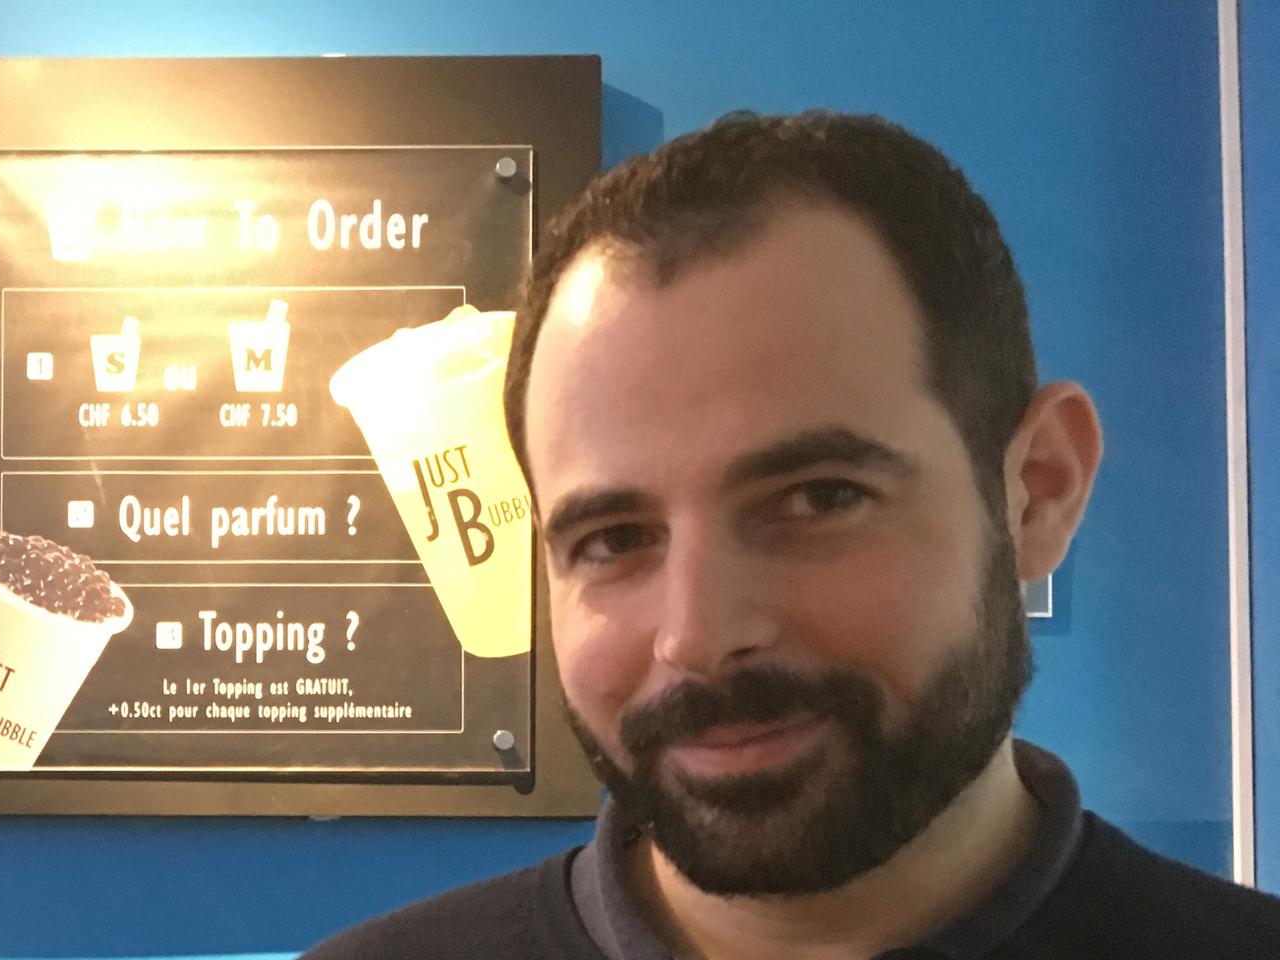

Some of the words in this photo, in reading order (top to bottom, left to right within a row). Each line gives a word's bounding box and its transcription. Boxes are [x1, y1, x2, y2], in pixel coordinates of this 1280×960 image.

[234, 200, 278, 250] To
[307, 199, 428, 251] Order
[106, 352, 125, 374] S
[245, 349, 273, 372] M
[79, 403, 110, 427] CHF
[121, 403, 159, 426] 6.50
[220, 404, 250, 427] CHF
[261, 404, 297, 426] 7.50
[413, 445, 470, 542] JUST
[119, 495, 189, 542] Quel
[212, 495, 325, 548] parfum
[348, 495, 360, 535] ?
[199, 611, 325, 663] Topping
[346, 611, 359, 650] ?
[164, 679, 176, 694] Le
[213, 678, 262, 699] Topping
[270, 682, 288, 694] est
[296, 679, 352, 696] GRATUIT,
[169, 706, 198, 722] pour
[206, 702, 250, 722] chaque
[258, 702, 306, 722] topping
[314, 702, 411, 722] supplémentaire
